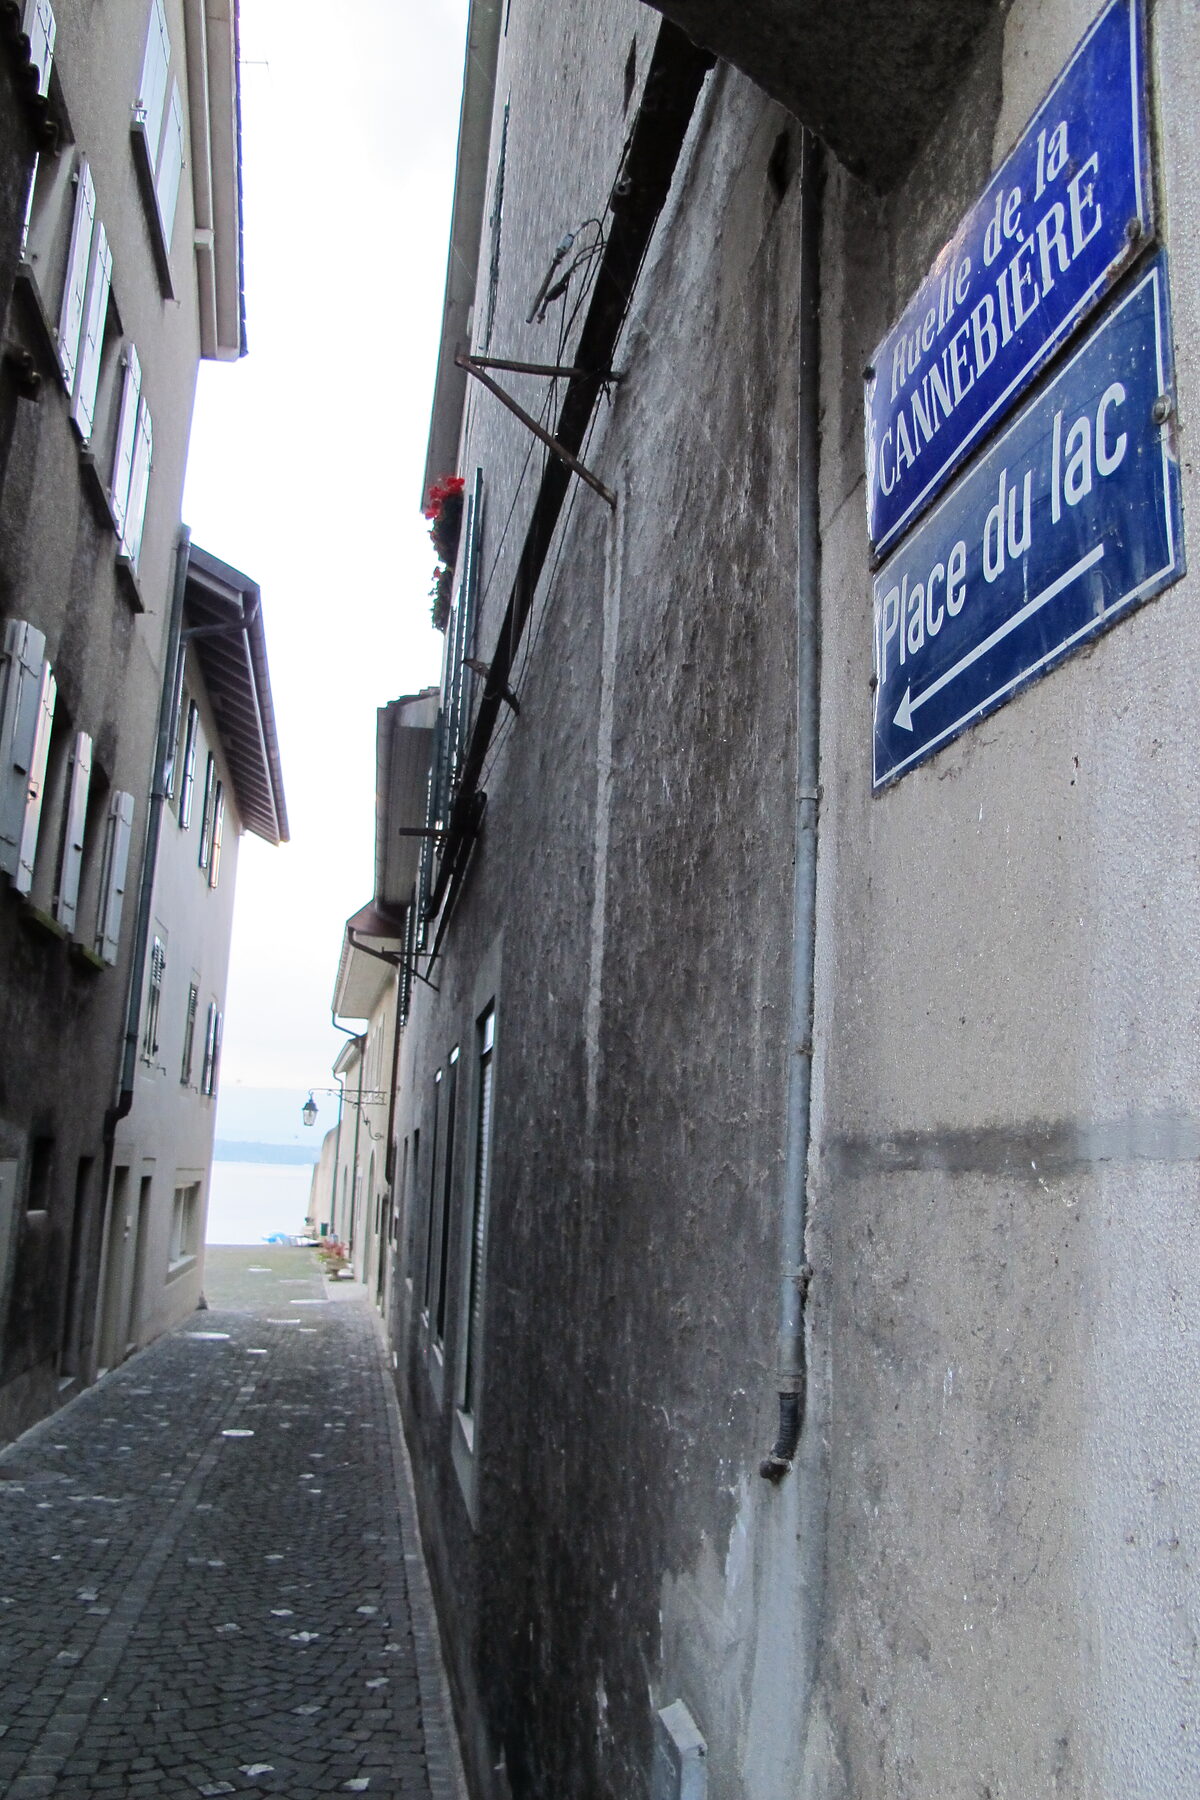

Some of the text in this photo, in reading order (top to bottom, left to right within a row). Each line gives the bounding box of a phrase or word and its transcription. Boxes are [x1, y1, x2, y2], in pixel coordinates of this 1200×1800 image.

[878, 151, 1103, 497] CANNEBIÈRE
[889, 120, 1070, 403] Ruelle de la
[879, 382, 1128, 685] Place du lac
